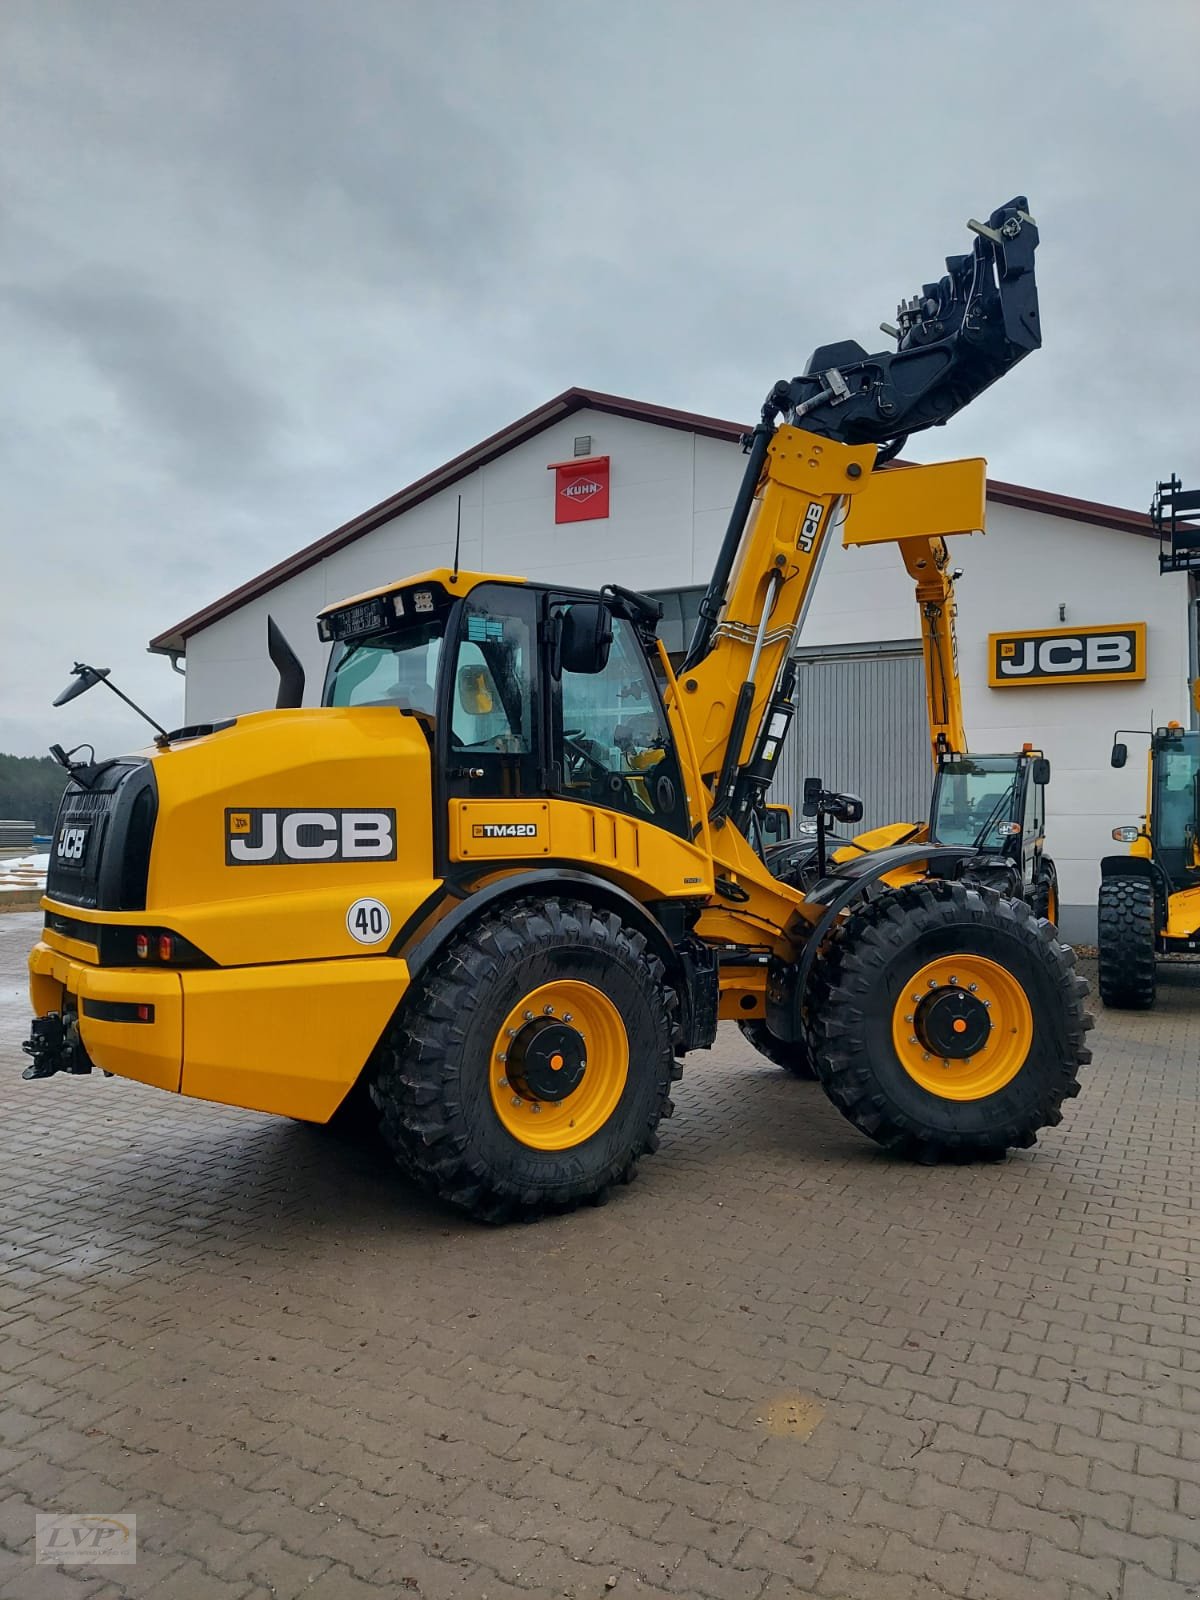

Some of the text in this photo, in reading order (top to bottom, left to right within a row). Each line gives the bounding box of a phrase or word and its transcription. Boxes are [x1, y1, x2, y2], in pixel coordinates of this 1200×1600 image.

[566, 483, 597, 496] KUHN
[799, 503, 823, 552] JCB
[1000, 635, 1132, 675] JCB
[57, 828, 86, 859] JCB
[230, 812, 393, 861] JCB
[484, 825, 536, 837] TM420
[355, 907, 383, 935] 40
